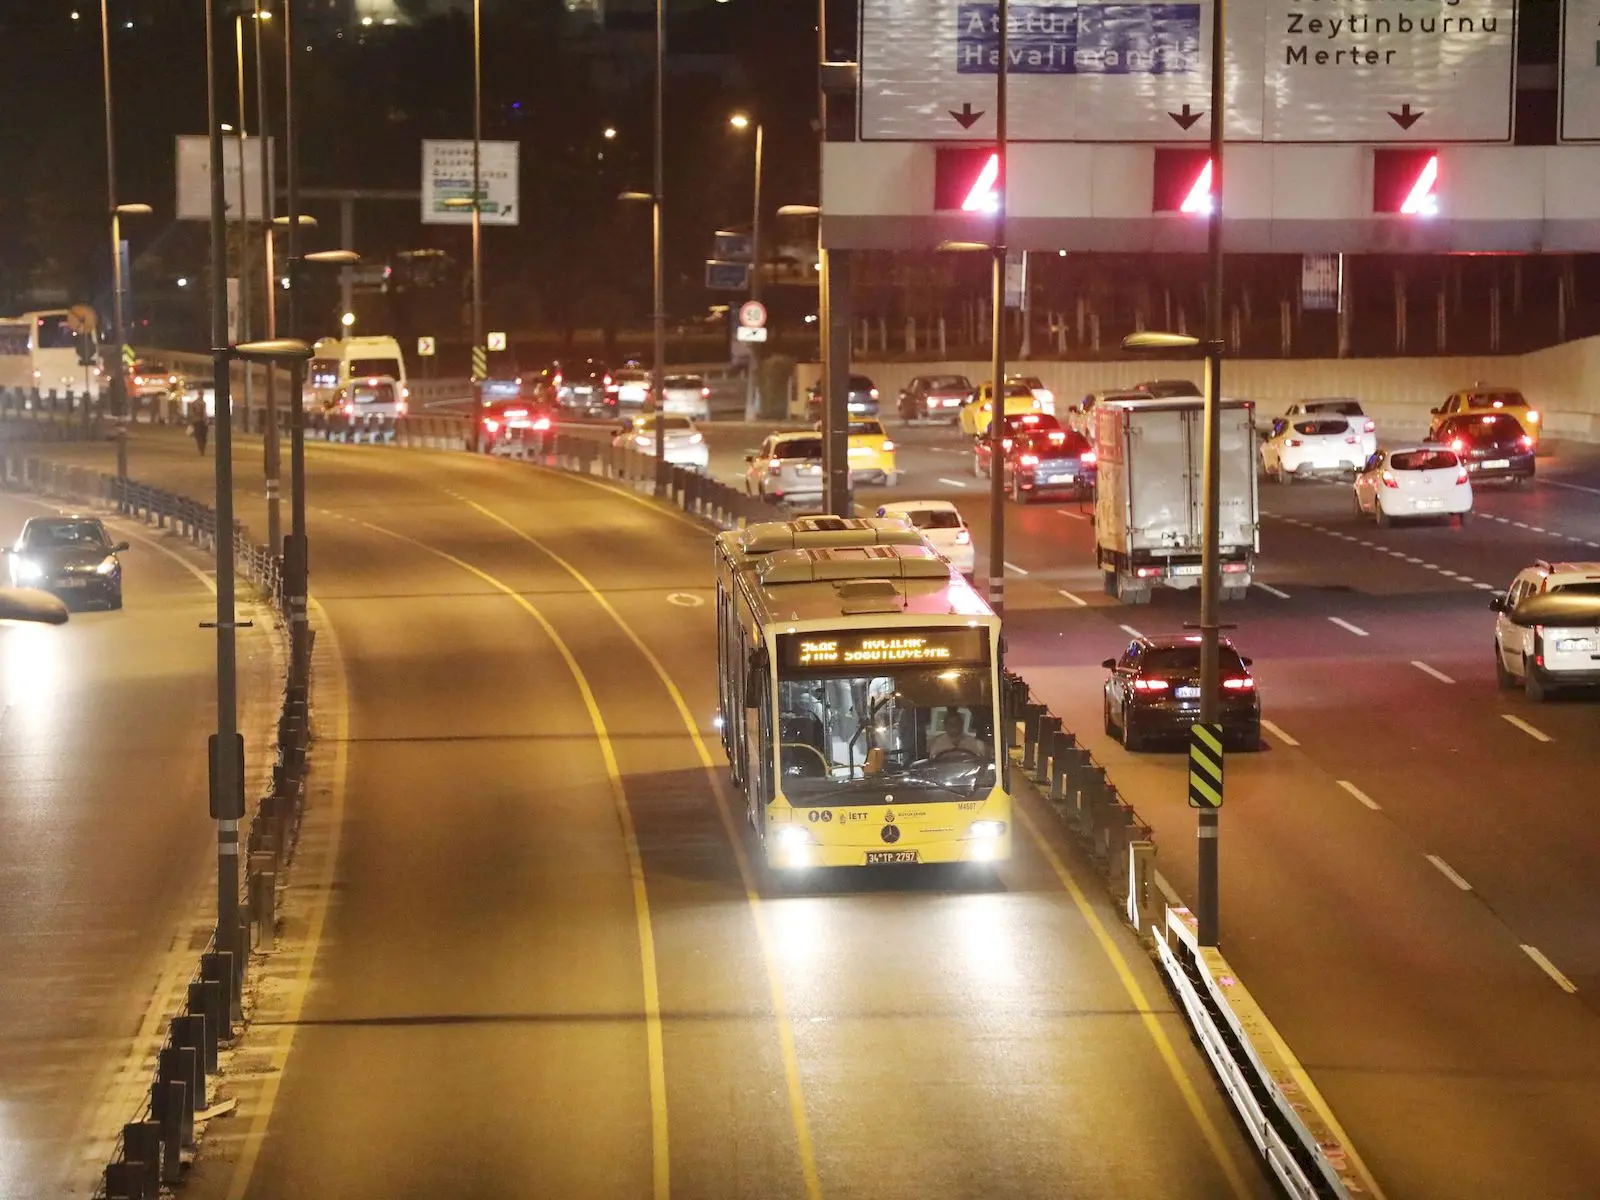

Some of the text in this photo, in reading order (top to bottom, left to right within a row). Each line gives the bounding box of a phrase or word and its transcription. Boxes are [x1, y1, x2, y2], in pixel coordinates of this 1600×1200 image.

[1287, 13, 1498, 39] Zeytinburnu
[1286, 45, 1397, 65] Merter
[868, 852, 915, 863] 34 TP 2797
